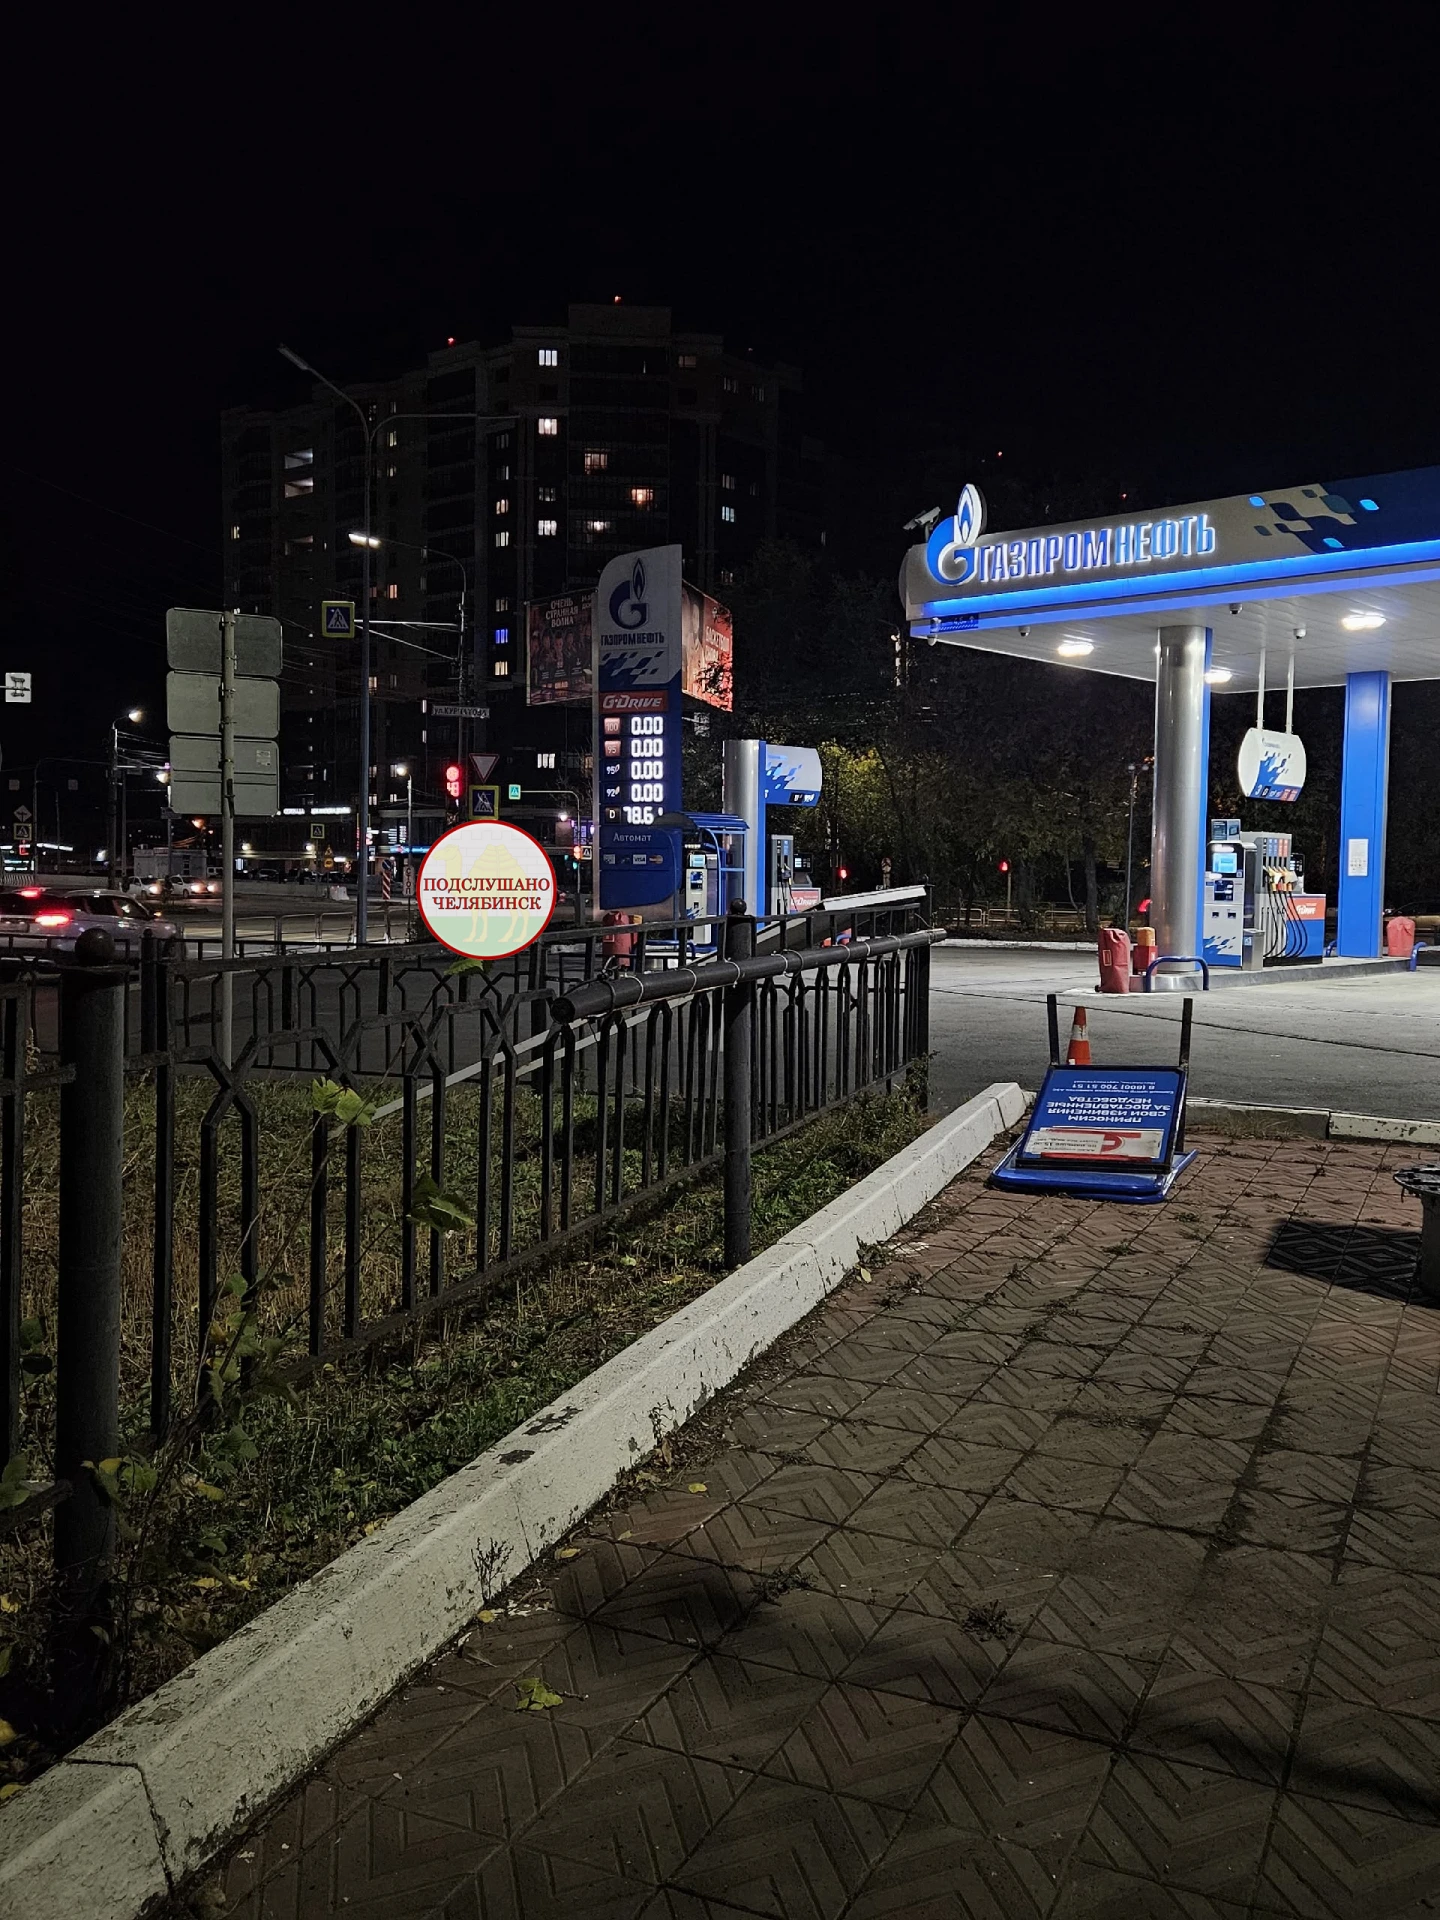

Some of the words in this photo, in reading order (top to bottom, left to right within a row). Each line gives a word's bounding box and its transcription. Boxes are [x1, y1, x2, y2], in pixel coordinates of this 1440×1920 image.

[979, 529, 1111, 583] ГАЗПРОМ
[1113, 514, 1217, 565] НЕФТЬ
[550, 597, 574, 610] ОЧЕНЬ
[545, 605, 579, 620] СТРАННАЯ
[551, 616, 574, 628] ВОЛНА
[606, 722, 619, 731] 100
[631, 716, 664, 736] 0.00
[607, 745, 617, 754] 95
[631, 738, 664, 758] 0.00
[606, 766, 616, 775] 95
[631, 761, 664, 780] 0.00
[606, 788, 616, 797] 92
[631, 783, 664, 803] 0.00
[609, 810, 616, 819] D
[613, 831, 653, 843] Автомат
[1046, 1101, 1152, 1110] ДОСТАВЛЕННЫЕ
[1068, 1096, 1152, 1104] НЕУДОБСТВА
[1047, 1108, 1128, 1116] ИЗВИНЕНИЯ
[1067, 1115, 1142, 1123] ПРИНОСИМ
